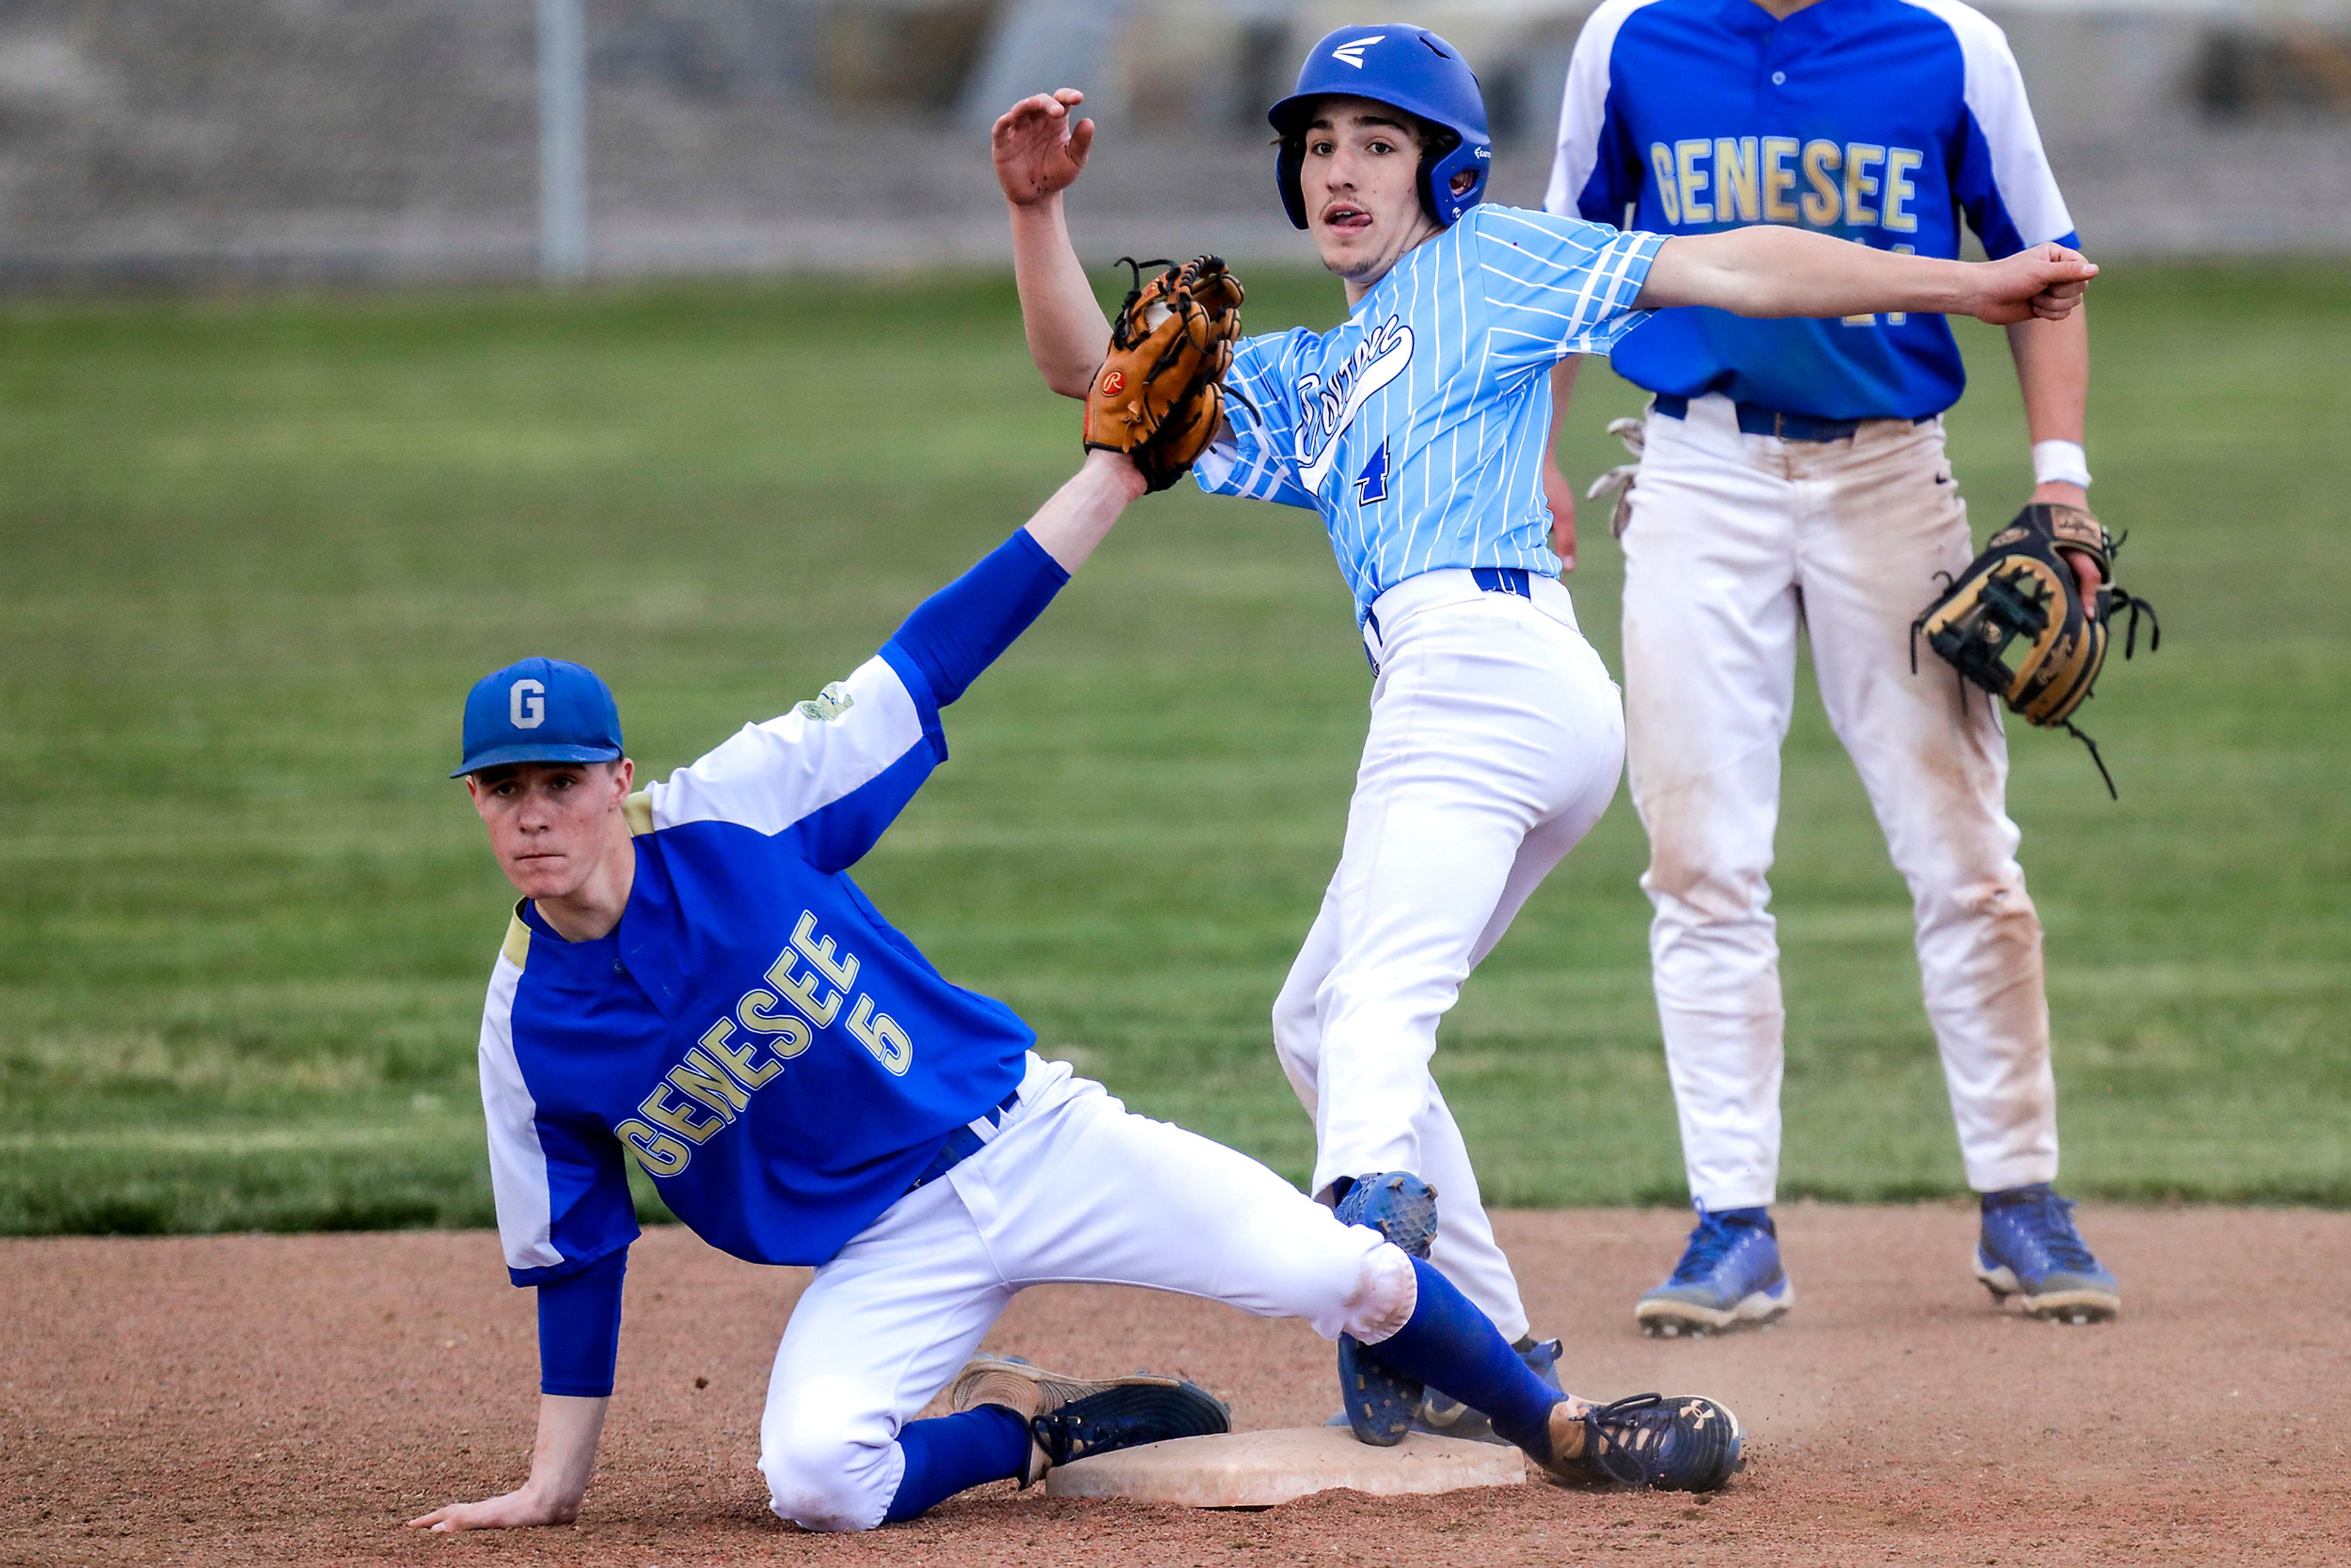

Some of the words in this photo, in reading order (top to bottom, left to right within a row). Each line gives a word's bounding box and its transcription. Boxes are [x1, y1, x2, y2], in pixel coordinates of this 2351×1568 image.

[1651, 136, 1922, 233] GENESEE
[1103, 372, 1122, 391] R
[1353, 433, 1390, 507] 4
[509, 678, 545, 729] G
[614, 909, 860, 1177] GENESEE
[846, 992, 913, 1076] 5
